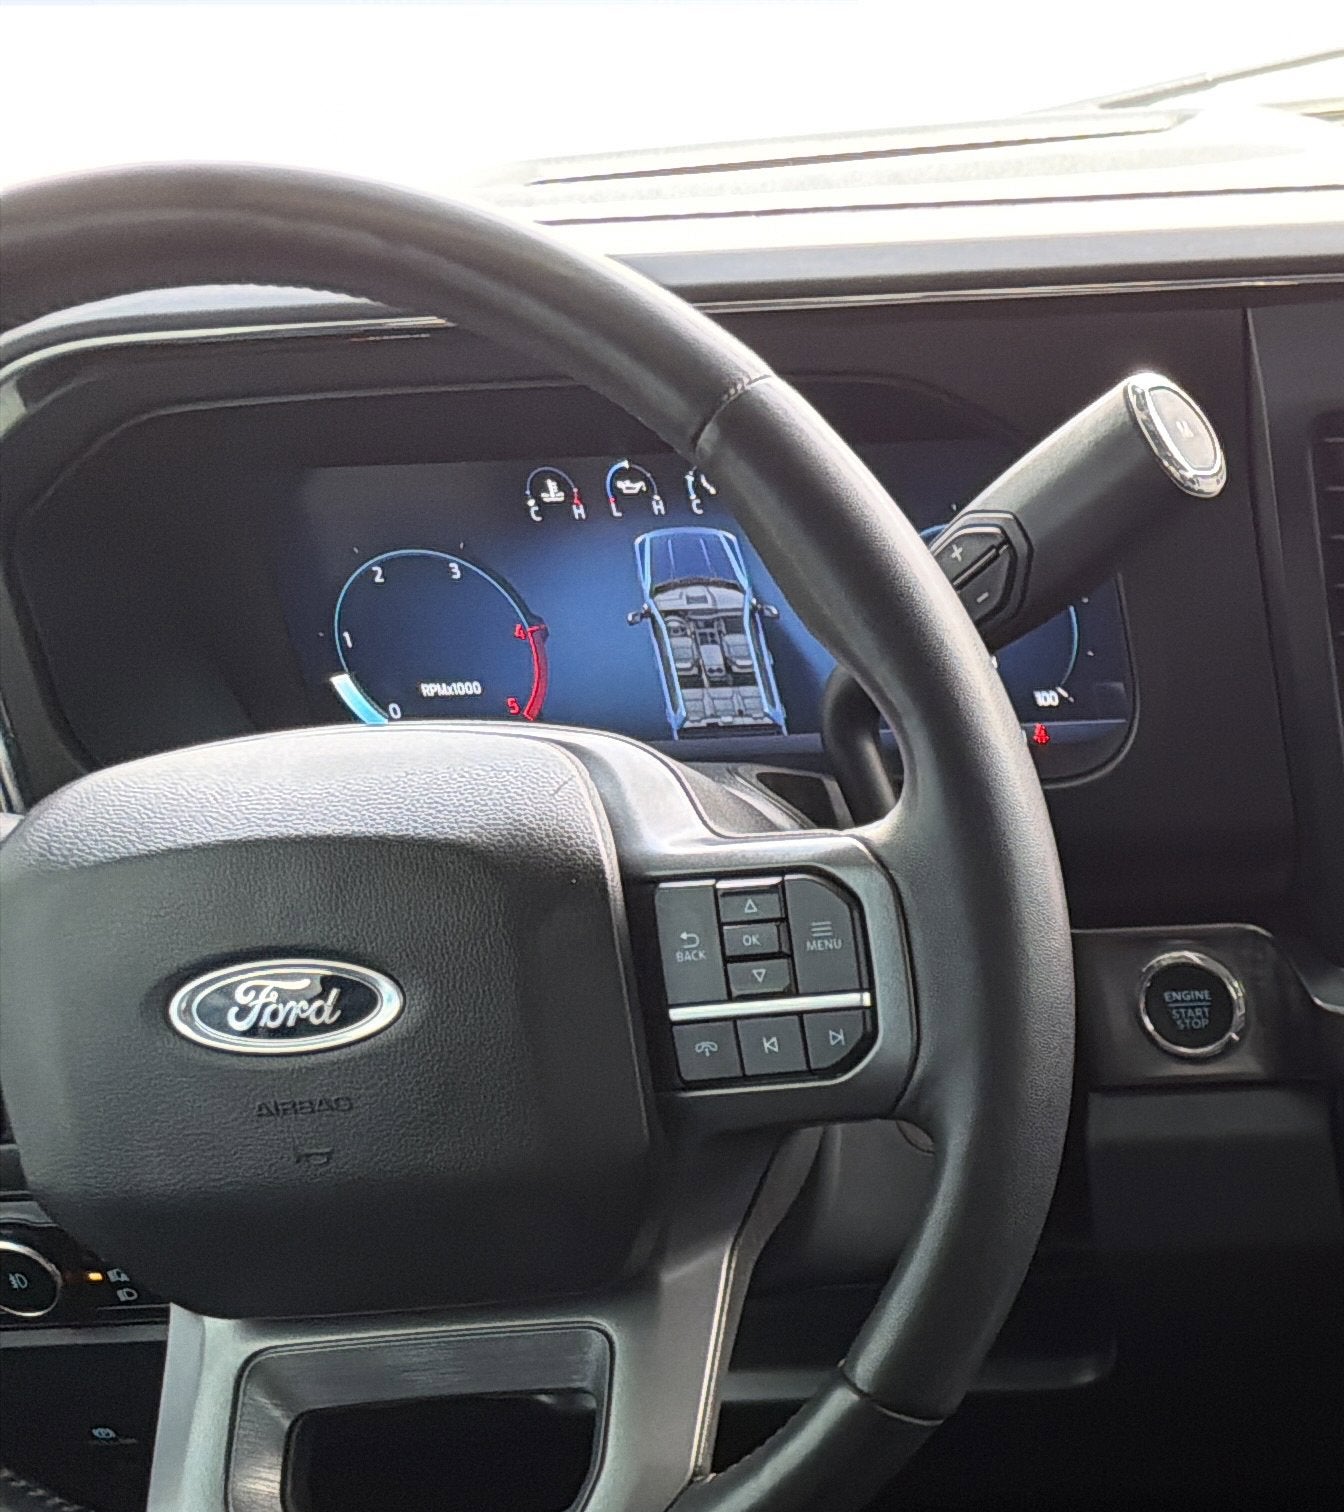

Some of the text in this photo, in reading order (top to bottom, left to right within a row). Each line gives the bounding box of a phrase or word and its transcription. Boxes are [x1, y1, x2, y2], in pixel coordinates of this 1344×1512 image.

[529, 506, 542, 522] C
[572, 504, 587, 520] H
[610, 501, 623, 518] L
[652, 499, 666, 516] H
[372, 567, 385, 583] 2
[449, 562, 461, 580] 3
[342, 631, 353, 649] 1
[513, 624, 526, 640] 4
[388, 702, 402, 720] 0
[507, 698, 520, 714] 5
[742, 934, 761, 947] OK
[806, 938, 843, 952] MENU
[676, 949, 707, 963] BACK
[1163, 989, 1213, 1003] ENGINE
[227, 979, 342, 1032] Ford
[1171, 1006, 1211, 1020] START
[1176, 1018, 1210, 1031] STOP
